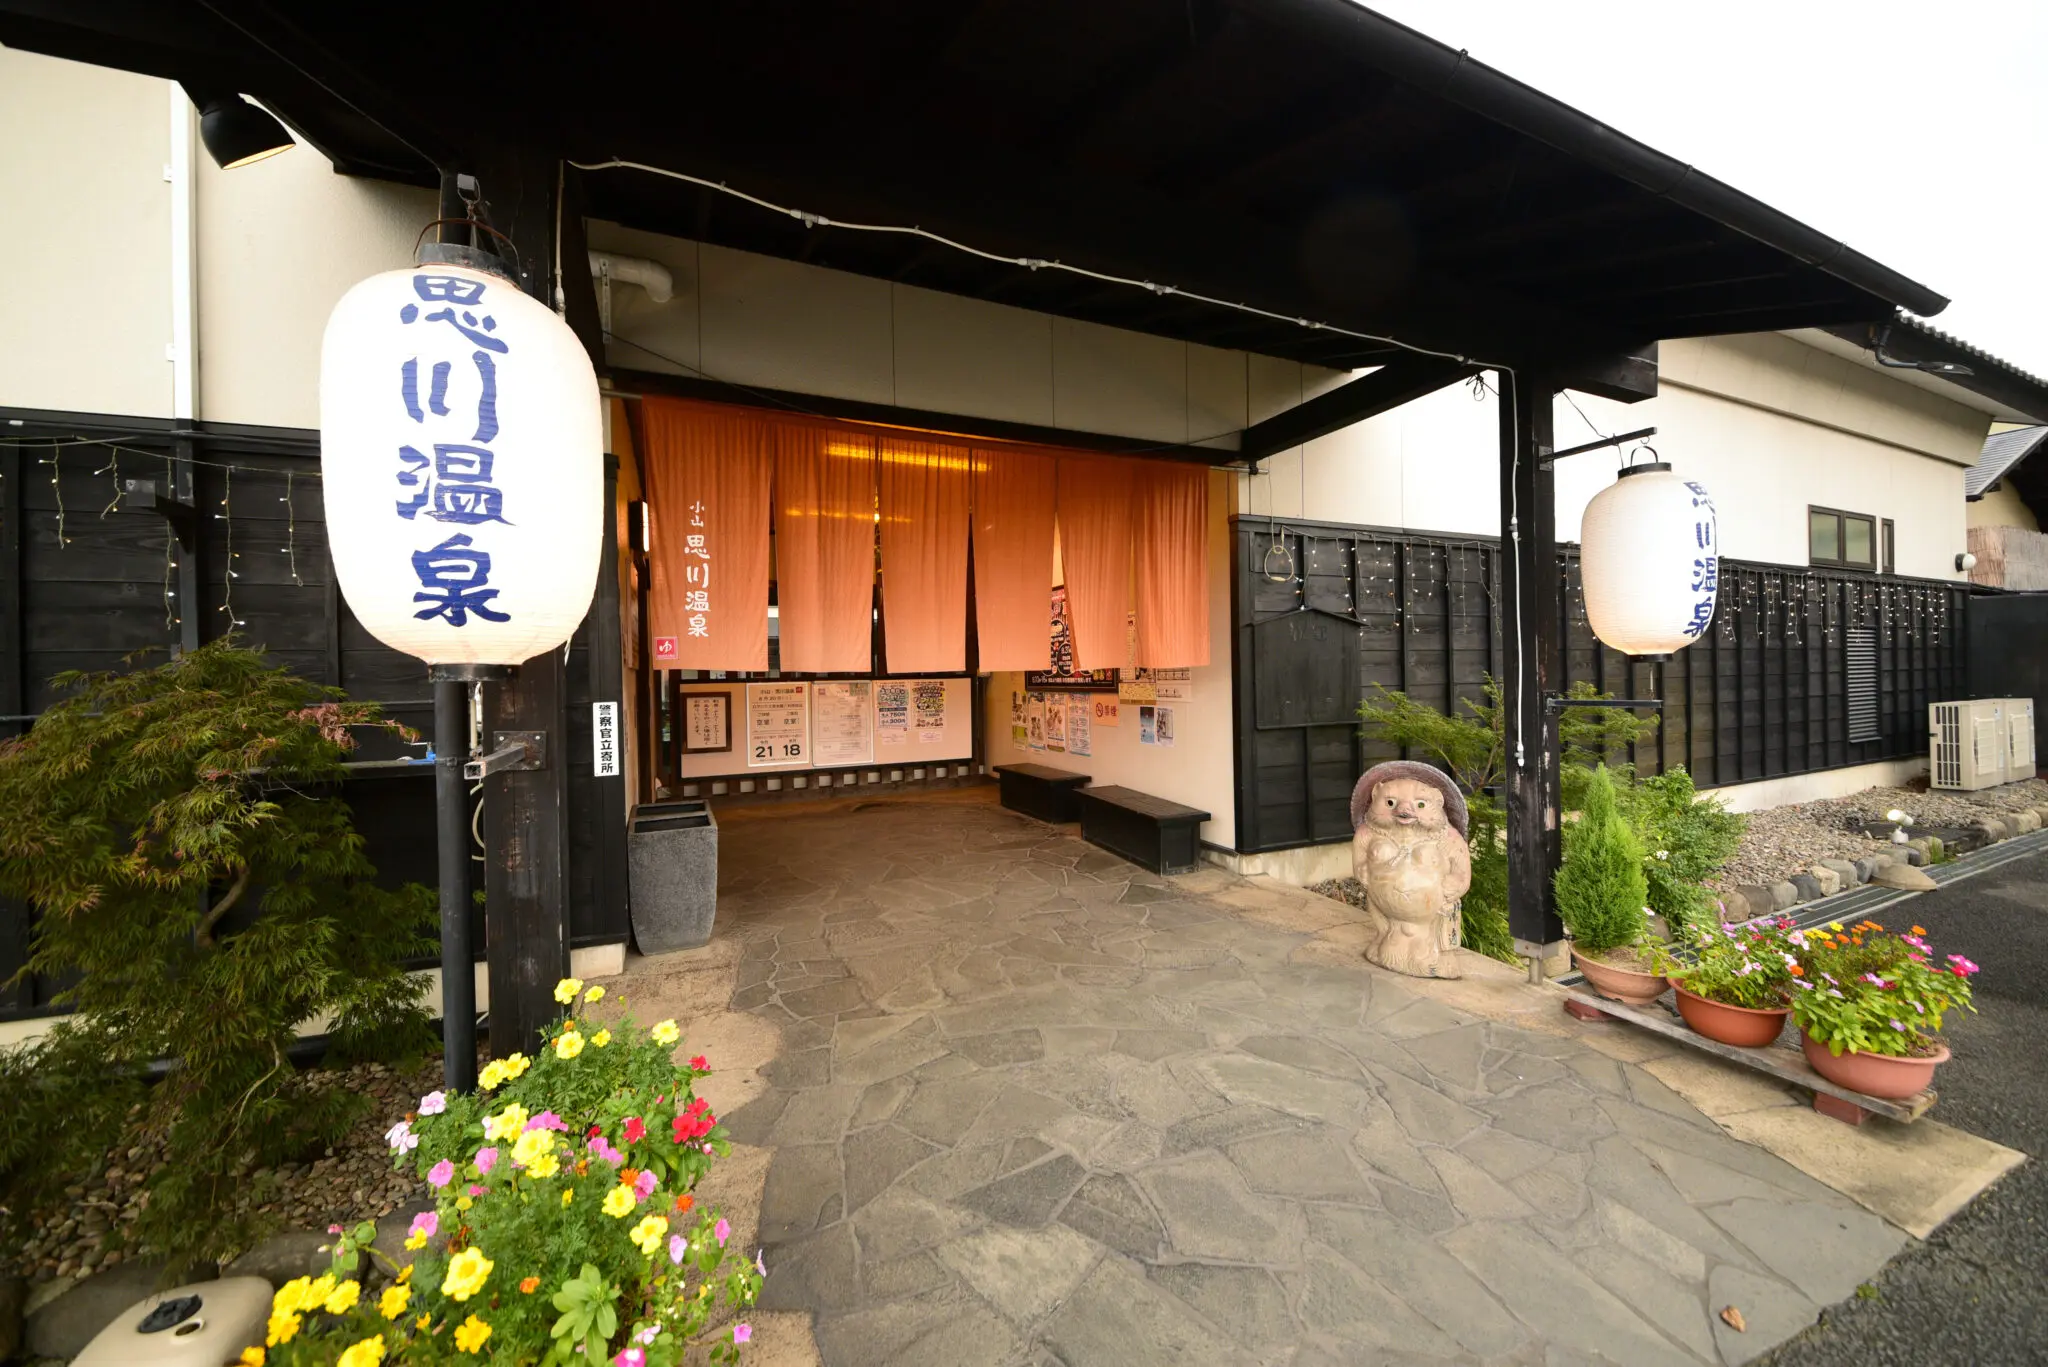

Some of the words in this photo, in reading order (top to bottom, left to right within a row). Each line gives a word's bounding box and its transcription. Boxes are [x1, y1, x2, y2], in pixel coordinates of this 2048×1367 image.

[396, 274, 517, 627] 思川温泉
[658, 640, 673, 654] ゆ
[599, 704, 613, 774] 警察官立寄所
[755, 745, 773, 758] 21
[783, 743, 801, 756] 18
